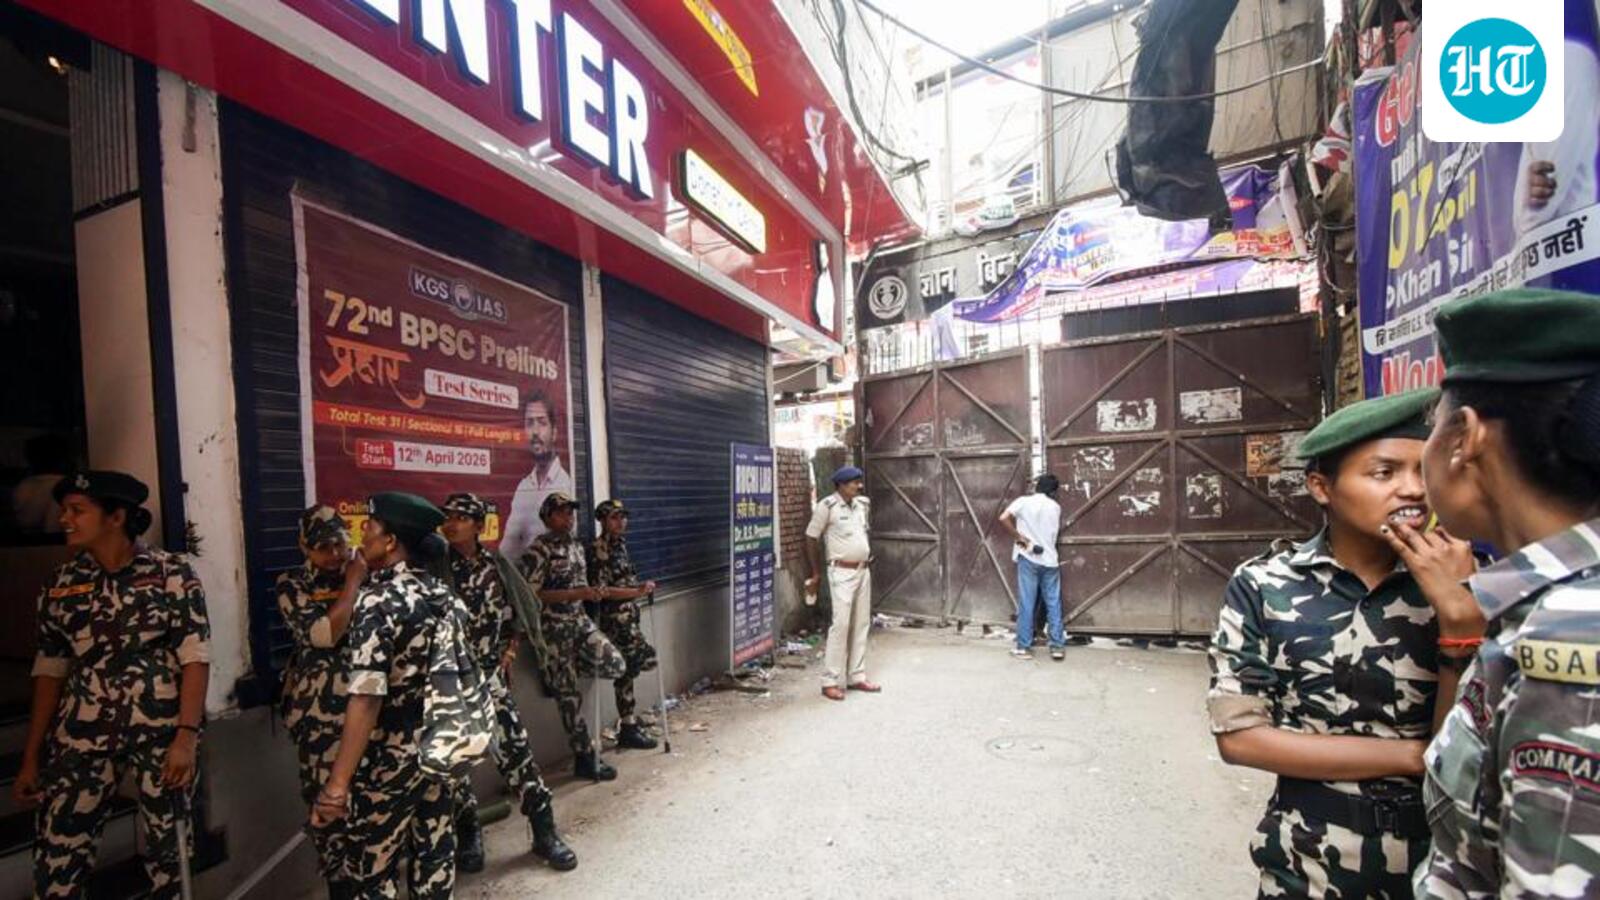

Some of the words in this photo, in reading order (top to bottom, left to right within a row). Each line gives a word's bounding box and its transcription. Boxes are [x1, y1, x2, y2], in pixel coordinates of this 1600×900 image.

[350, 0, 654, 199] TER
[1541, 215, 1588, 259] नहीं
[414, 272, 449, 300] KGS
[475, 297, 504, 319] IAS
[1398, 259, 1441, 305] Khan
[324, 289, 392, 335] 72nd
[400, 311, 476, 361] BPSC
[480, 335, 558, 381] Prelims
[434, 374, 466, 397] Test
[470, 383, 513, 405] Series
[329, 408, 361, 423] Total
[364, 413, 387, 427] Test
[361, 453, 393, 466] Starts
[363, 442, 385, 454] Test
[398, 447, 423, 463] 12th
[425, 451, 455, 468] April
[457, 452, 488, 468] 2026
[339, 501, 369, 514] Onlin
